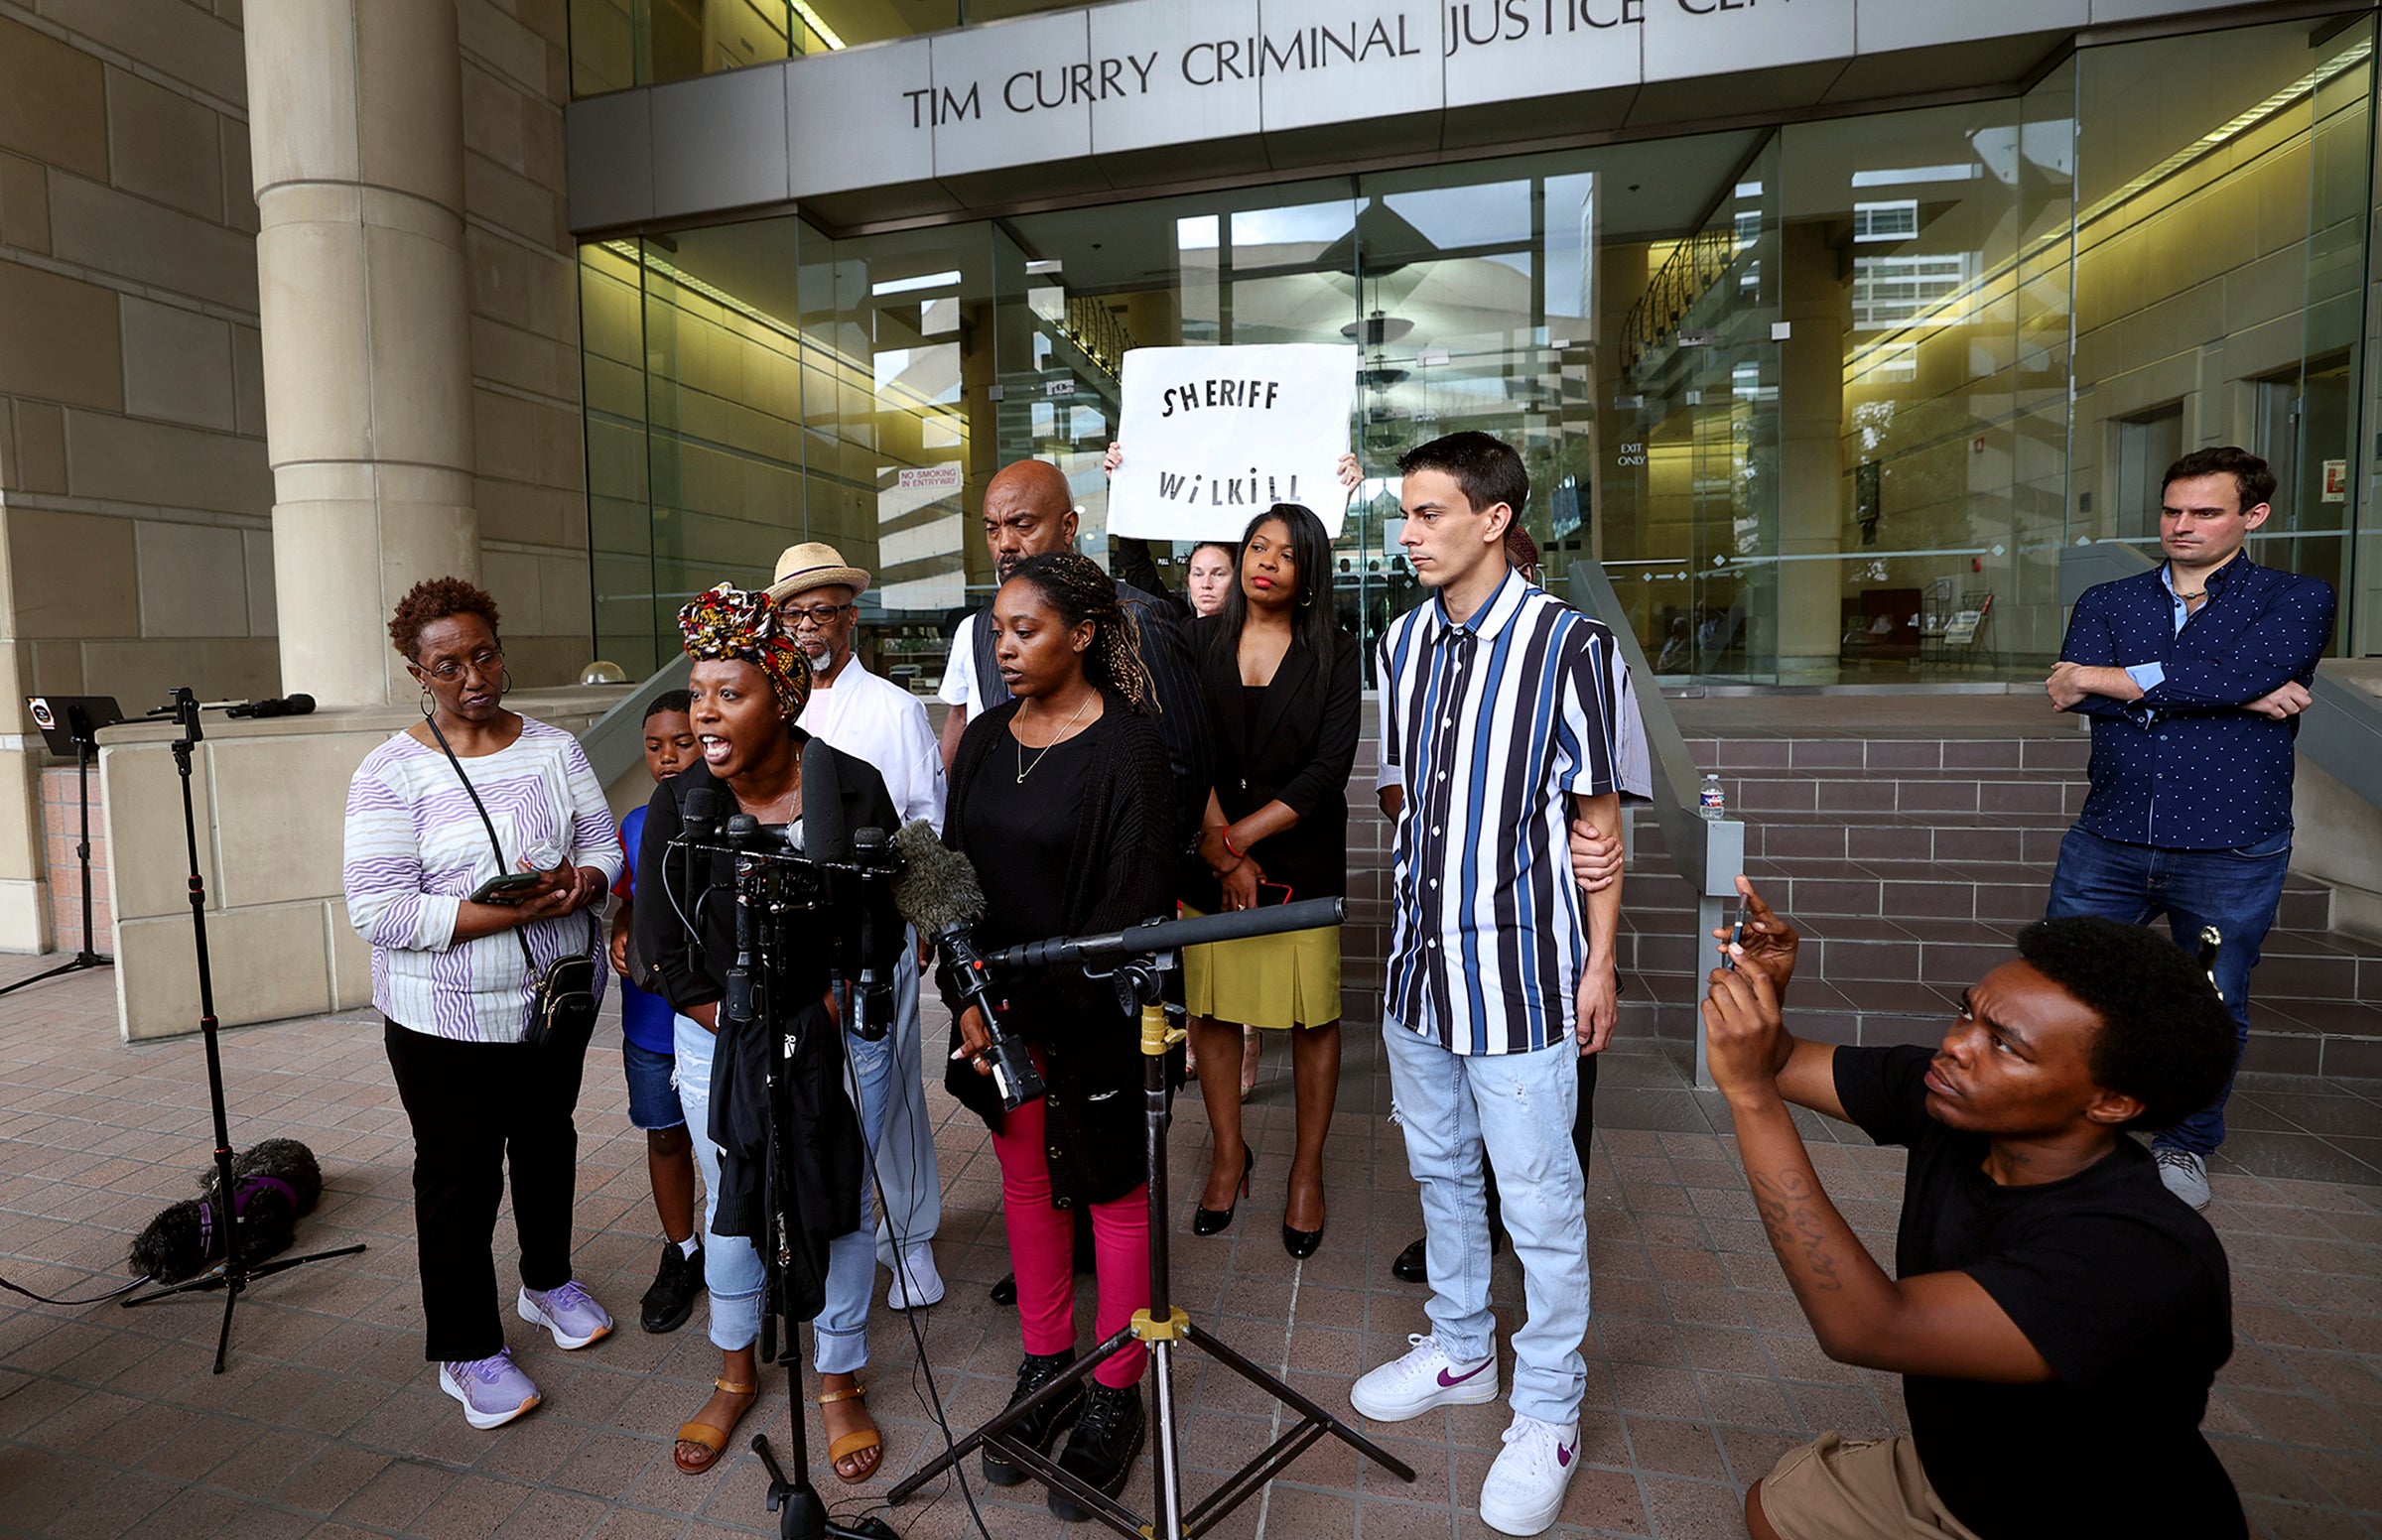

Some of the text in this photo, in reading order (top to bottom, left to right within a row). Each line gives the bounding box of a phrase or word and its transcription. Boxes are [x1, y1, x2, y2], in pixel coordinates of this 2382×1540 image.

[902, 0, 1645, 128] TIM CURRY CRIMINAL JUSTICE
[1161, 379, 1279, 418] SHERIFF
[1621, 443, 1643, 453] EXIT
[1617, 455, 1646, 466] ONLY
[901, 468, 956, 480] NO SMOKING
[913, 477, 956, 487] ENTRYWAY
